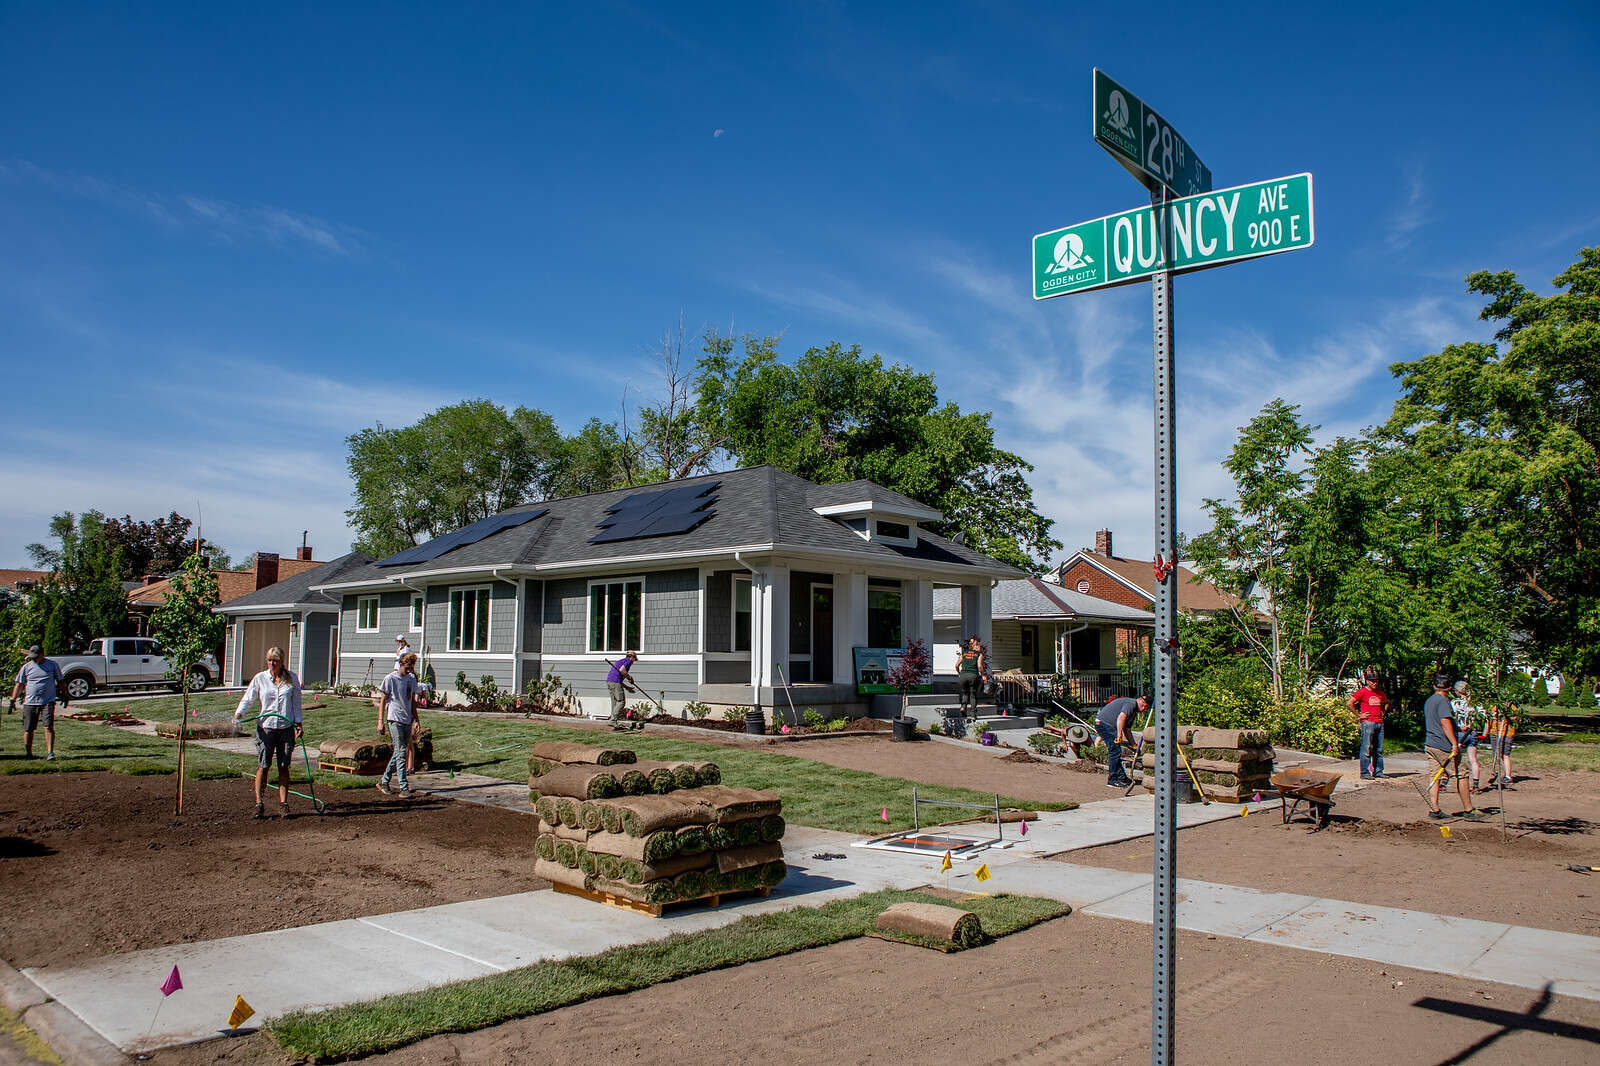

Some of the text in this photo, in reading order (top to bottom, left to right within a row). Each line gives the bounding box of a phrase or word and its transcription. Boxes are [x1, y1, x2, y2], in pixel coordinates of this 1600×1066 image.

[1101, 125, 1138, 154] OGDEN CITY
[1194, 159, 1202, 185] ST
[1257, 183, 1289, 215] AVE
[1113, 192, 1241, 274] QUINCY
[1247, 214, 1302, 249] 900 E
[1042, 269, 1097, 289] OGDEN CITY
